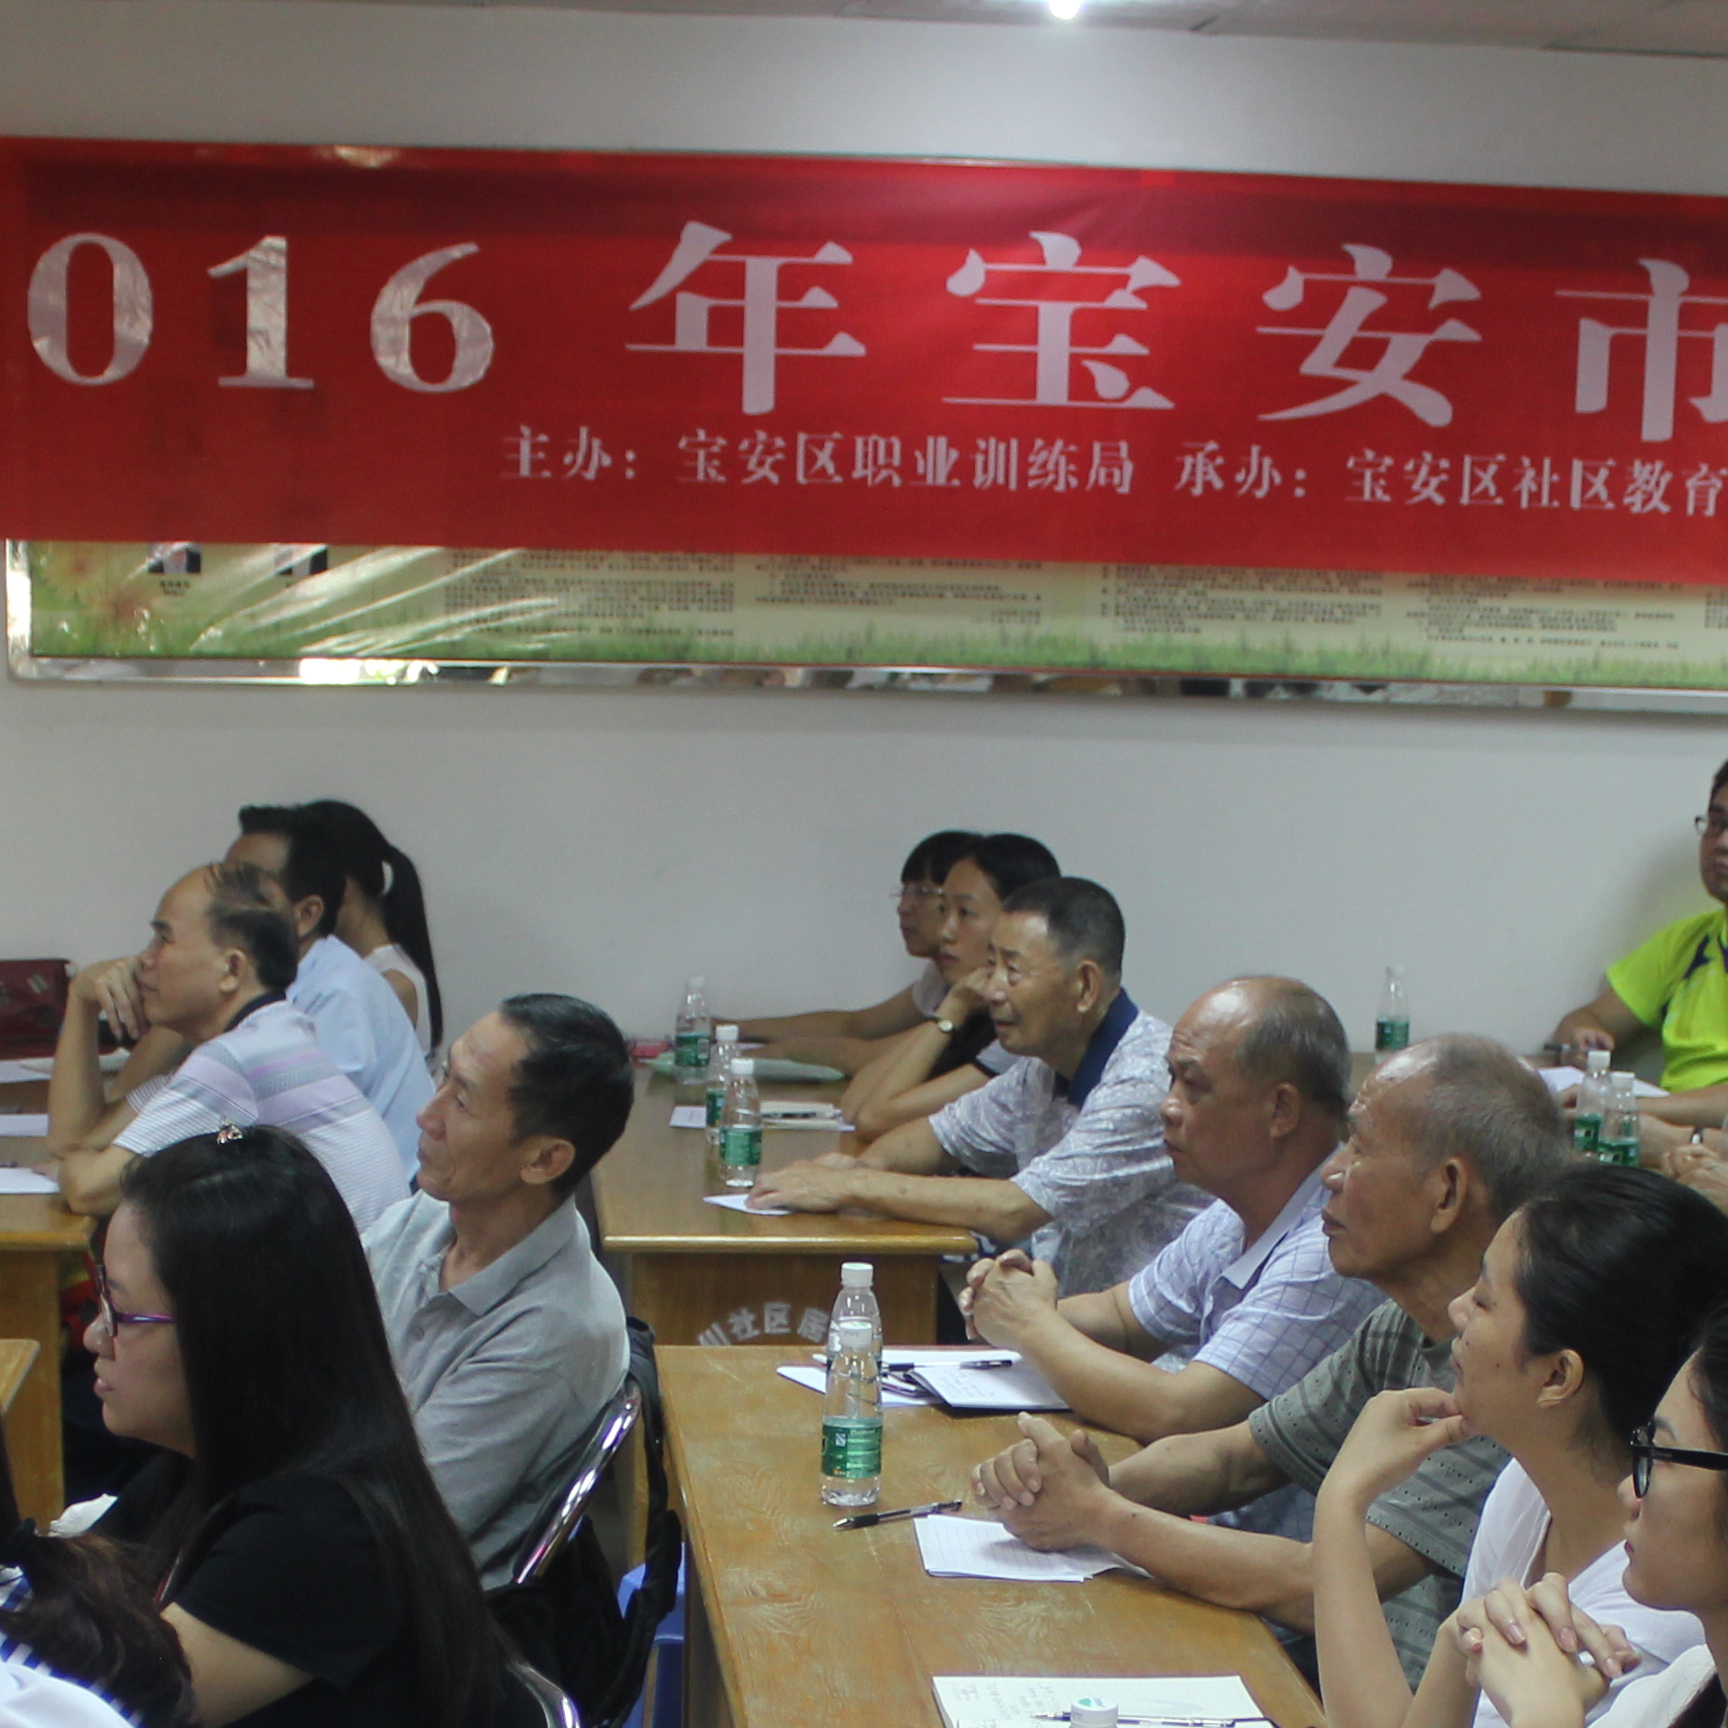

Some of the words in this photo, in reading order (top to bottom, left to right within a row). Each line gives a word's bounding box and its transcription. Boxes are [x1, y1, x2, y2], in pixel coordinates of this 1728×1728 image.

[500, 426, 1134, 495] 主办：宝安区职业训练局
